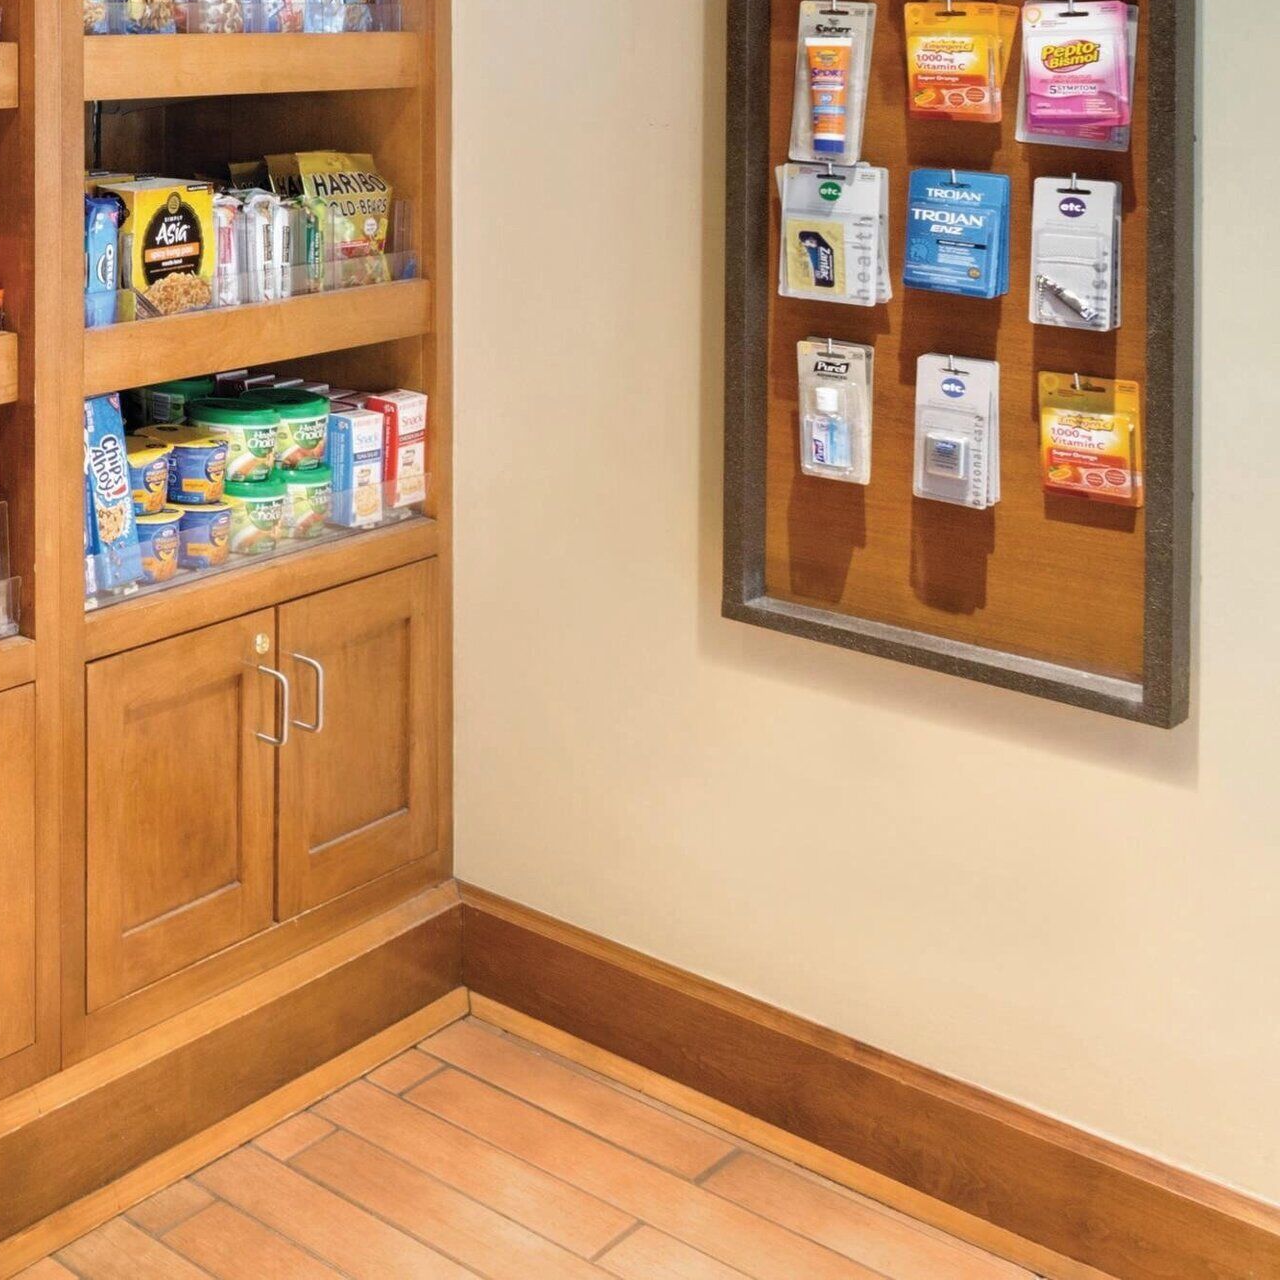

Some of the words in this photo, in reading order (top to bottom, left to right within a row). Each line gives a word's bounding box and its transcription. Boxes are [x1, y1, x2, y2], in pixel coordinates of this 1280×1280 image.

[815, 24, 852, 36] SPORT
[1048, 49, 1099, 69] Bismol
[916, 61, 955, 71] Vitamin
[957, 62, 966, 71] C
[1049, 84, 1057, 94] 5
[312, 171, 387, 197] HARIBO
[820, 187, 842, 197] etc.
[925, 187, 983, 202] TROJAN
[1060, 202, 1086, 213] etc.
[912, 207, 986, 227] TROJAN
[155, 222, 189, 246] Asia
[930, 224, 962, 235] ENZ
[816, 360, 850, 374] Purell
[941, 382, 966, 394] etc.
[1051, 436, 1095, 451] Vitamin
[1096, 440, 1106, 451] C
